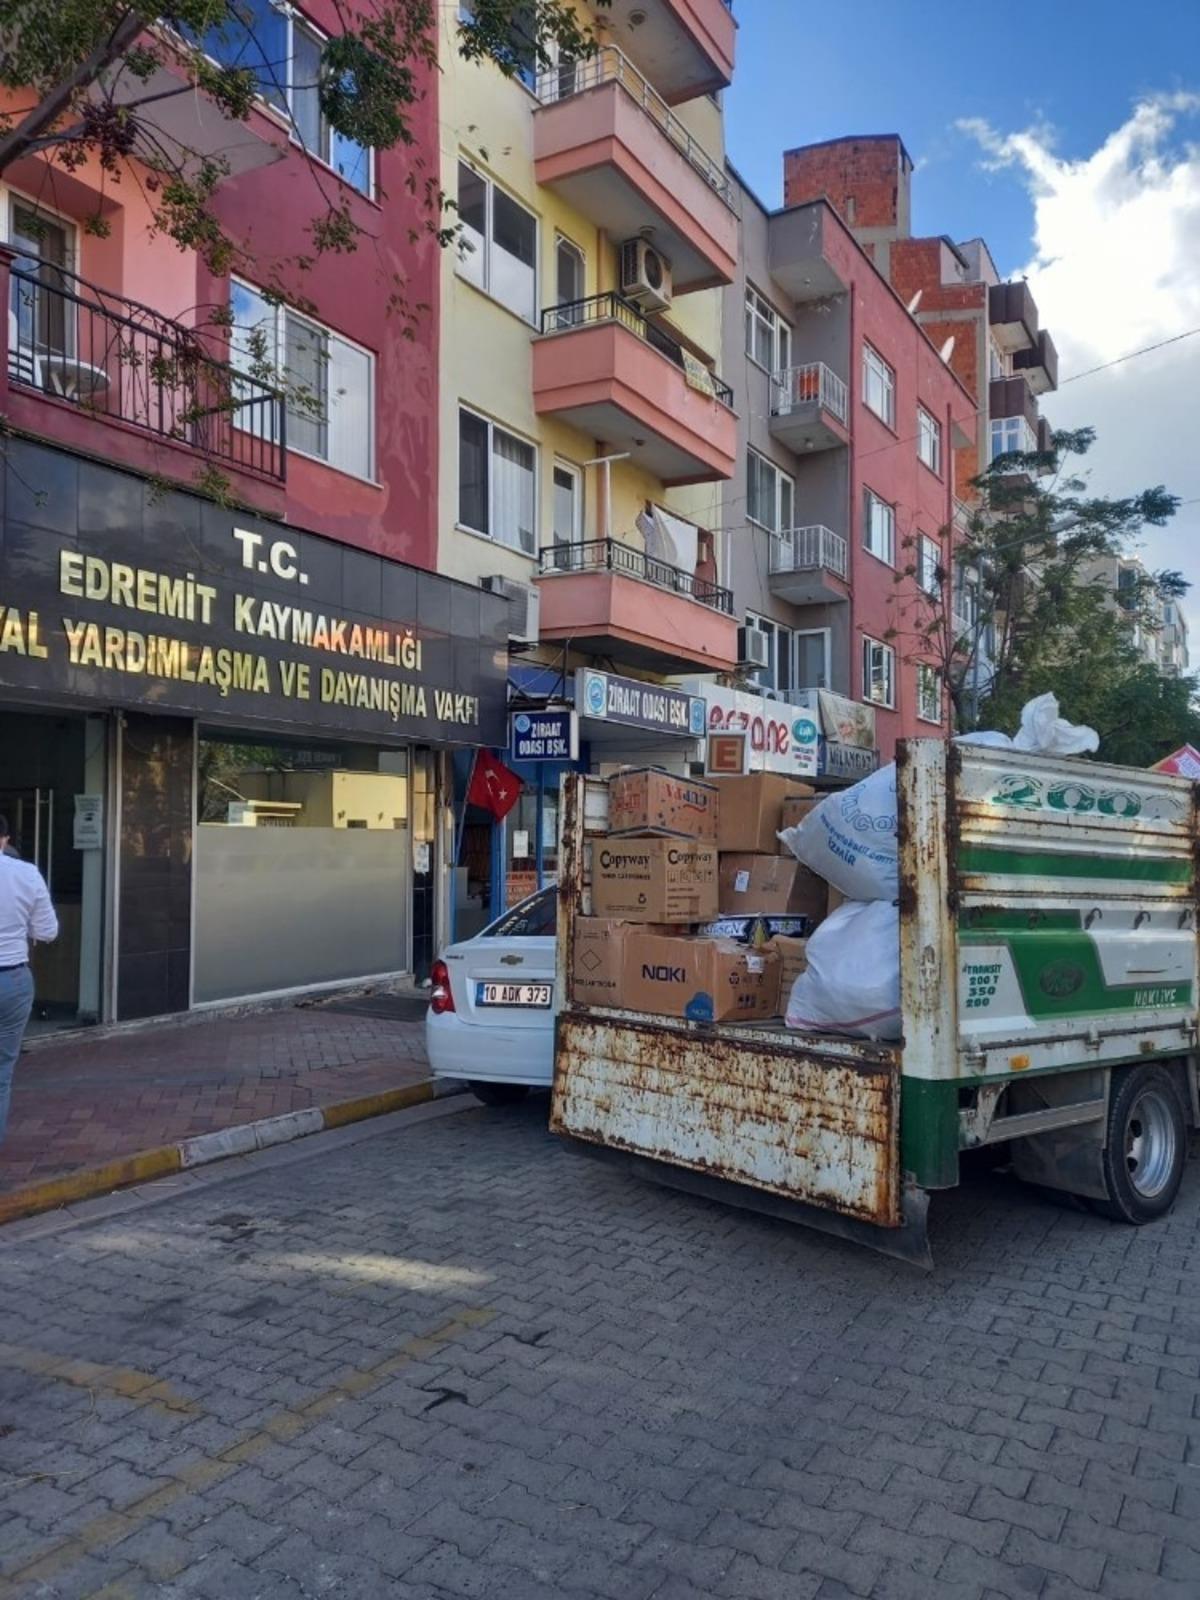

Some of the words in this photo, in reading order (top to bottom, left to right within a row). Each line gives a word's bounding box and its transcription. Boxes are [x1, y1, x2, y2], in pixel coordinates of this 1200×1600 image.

[233, 528, 309, 584] T.C.
[60, 550, 217, 625] EDREMİT
[234, 594, 422, 672] KAYMAKAMLIĞI
[0, 606, 48, 659] AL
[63, 618, 270, 697] YARDIMLAŞMA
[279, 660, 311, 699] VE
[321, 668, 428, 722] DAYANIŞMA
[434, 691, 480, 726] VAKFI
[608, 682, 641, 717] ZİRAAT
[642, 692, 669, 722] ODASI
[531, 721, 562, 738] ZİRAAT
[519, 741, 545, 755] ODASI
[716, 740, 737, 768] E
[600, 850, 650, 869] Copyway
[667, 849, 712, 865] Copyway
[642, 964, 686, 984] NOKI
[969, 975, 991, 986] 200
[993, 975, 999, 984] T
[486, 985, 497, 1001] 10
[502, 985, 521, 1002] ADK
[527, 985, 548, 1002] 373
[968, 986, 996, 997] 350
